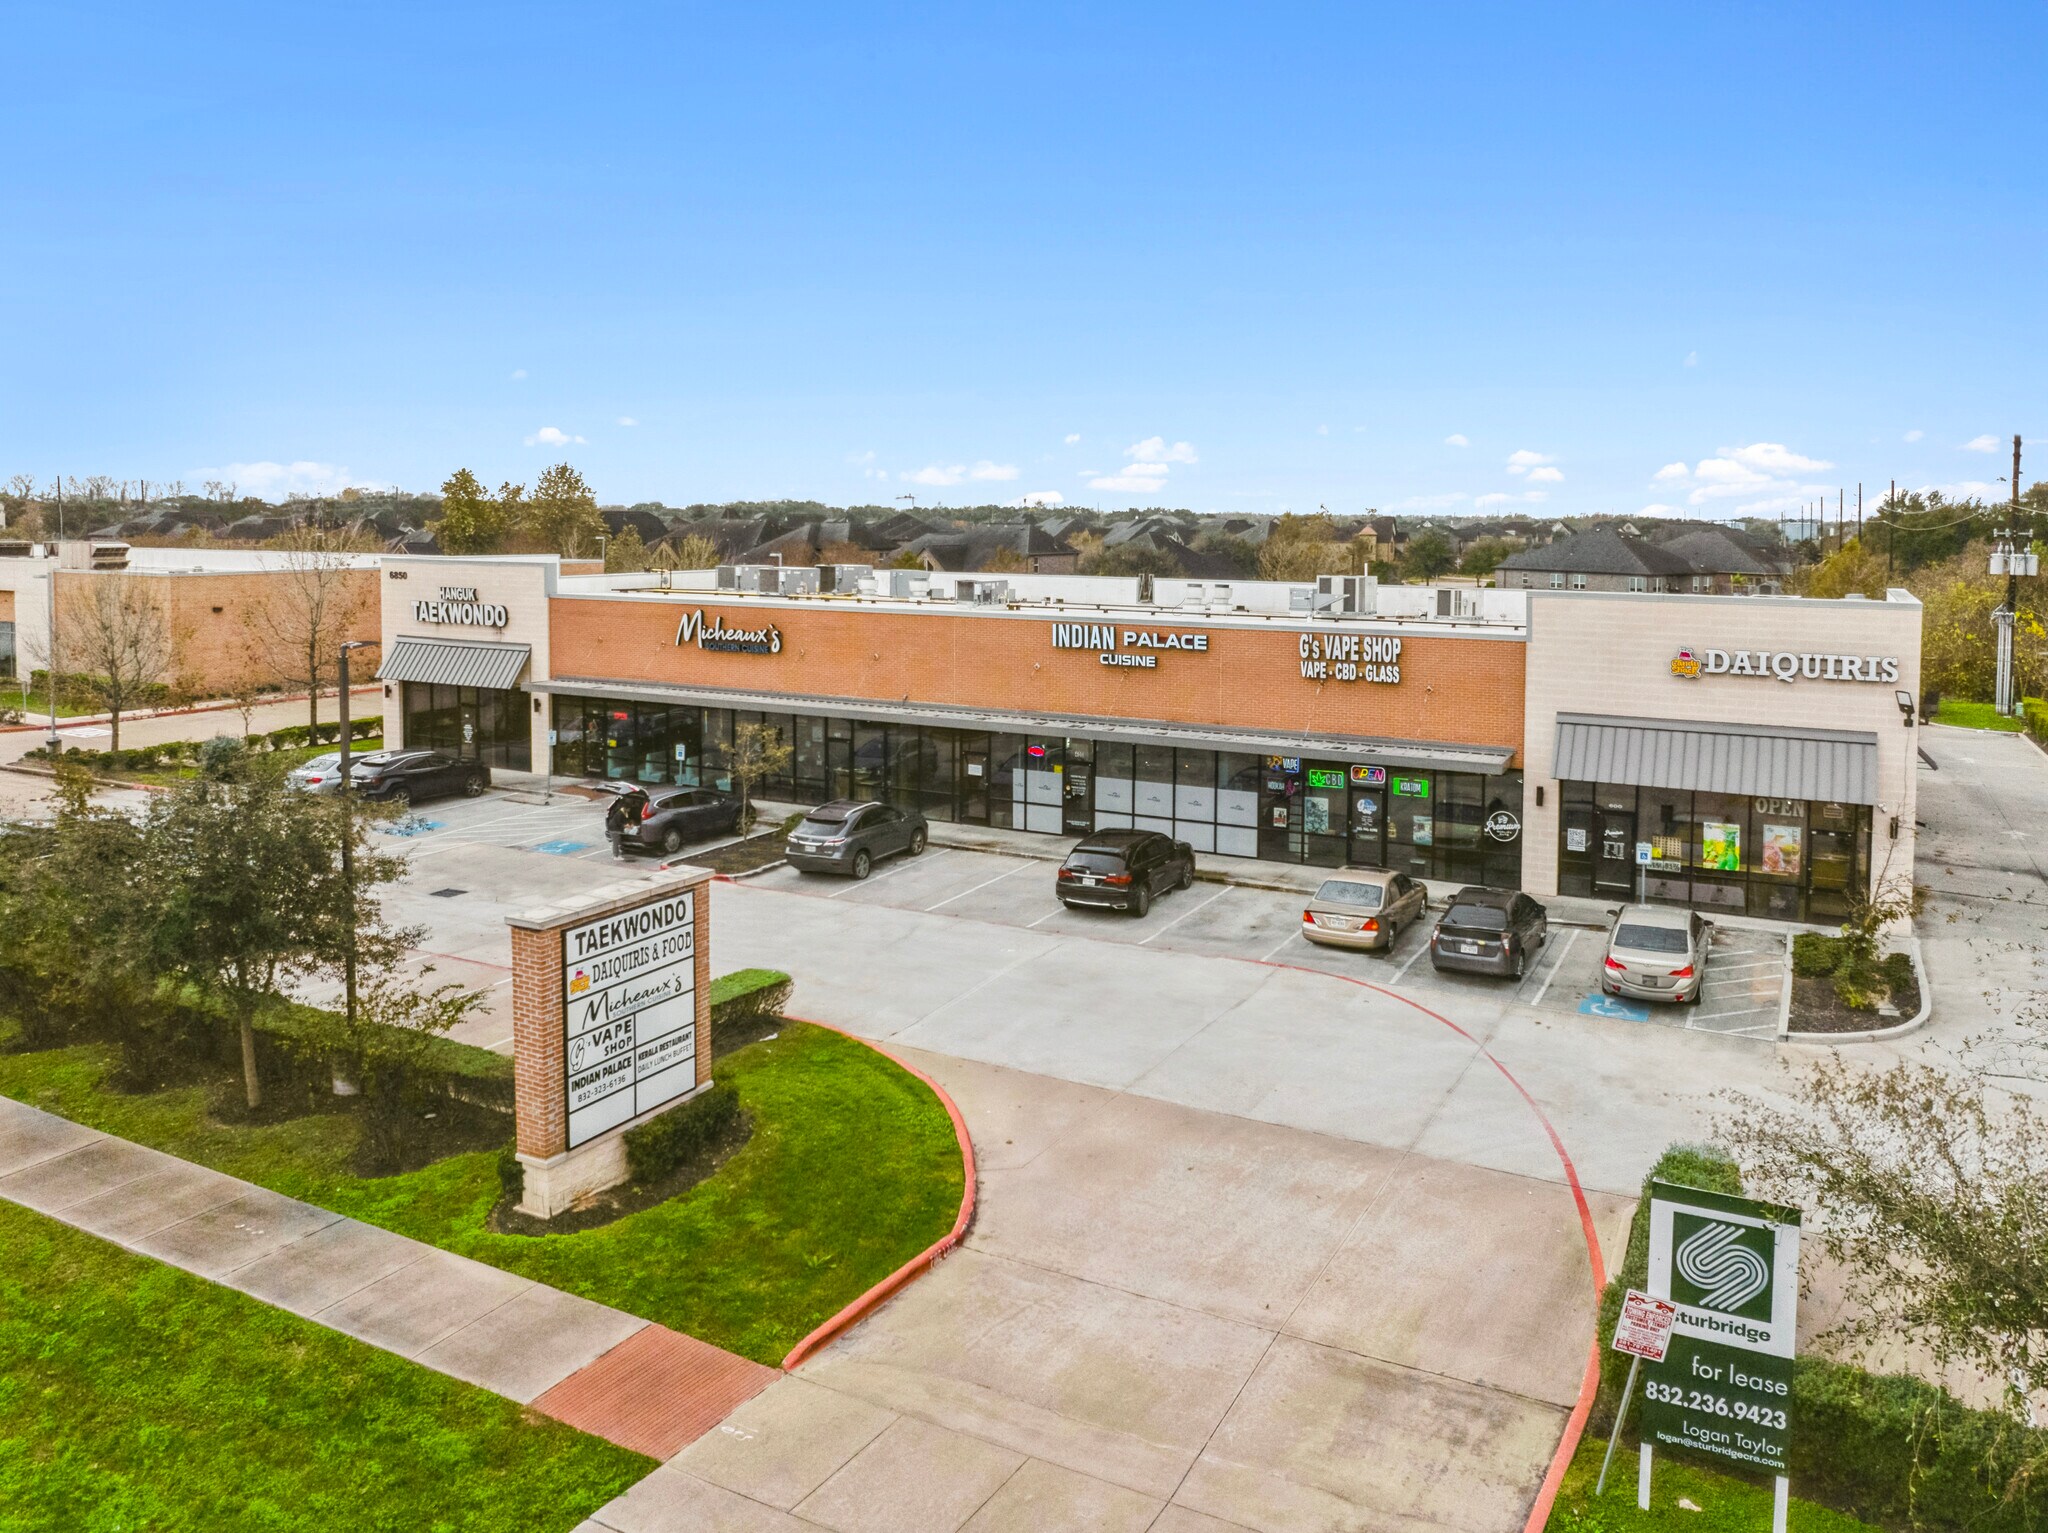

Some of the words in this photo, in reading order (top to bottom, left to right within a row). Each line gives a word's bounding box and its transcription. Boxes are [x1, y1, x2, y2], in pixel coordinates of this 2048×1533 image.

[389, 571, 408, 580] 6850
[440, 587, 478, 601] HANGUK
[411, 601, 508, 627] TAEKWONDO
[675, 609, 781, 653] Micheaux's
[1052, 623, 1115, 650] INDIAN
[1123, 632, 1208, 650] PALACE
[705, 642, 740, 652] SOUTHERN
[742, 644, 770, 654] CUISINE
[1100, 654, 1156, 667] CUISINE
[1299, 633, 1320, 659] G's
[1323, 635, 1359, 661] VAPE
[1363, 636, 1401, 663] SHOP
[1300, 660, 1327, 679] VAPE
[1335, 663, 1357, 680] CBD
[1365, 664, 1400, 684] GLASS
[1705, 649, 1899, 683] DAIQUIRIS
[1325, 773, 1343, 786] CBD
[1352, 768, 1384, 781] OPEN
[1755, 798, 1805, 817] OPEN
[575, 900, 686, 956] TAEKWONDO
[592, 946, 650, 984] DAIQUIRIS
[652, 943, 660, 961] &
[662, 931, 692, 958] FOOD
[582, 972, 682, 1030] Micheaux's
[613, 1001, 646, 1018] SOUTHERN
[647, 991, 672, 1004] CUISINE
[592, 1019, 632, 1048] VAPE
[604, 1036, 633, 1057] SHOP
[638, 1046, 658, 1061] KERALA
[660, 1031, 693, 1052] RESTAURANT
[638, 1061, 653, 1073] DAILY
[654, 1052, 672, 1066] LUNCH
[673, 1043, 693, 1058] BUFFET
[571, 1067, 601, 1092] INDIAN
[602, 1056, 632, 1079] PALACE
[577, 1074, 626, 1102] 832-323-6136
[1691, 1355, 1722, 1381] for
[1729, 1364, 1788, 1396] lease
[1645, 1381, 1787, 1430] 832.236.9423
[1656, 1431, 1785, 1469] logan@sturbridgecre.com
[1683, 1420, 1730, 1444] Logan
[1735, 1432, 1783, 1457] Taylor
